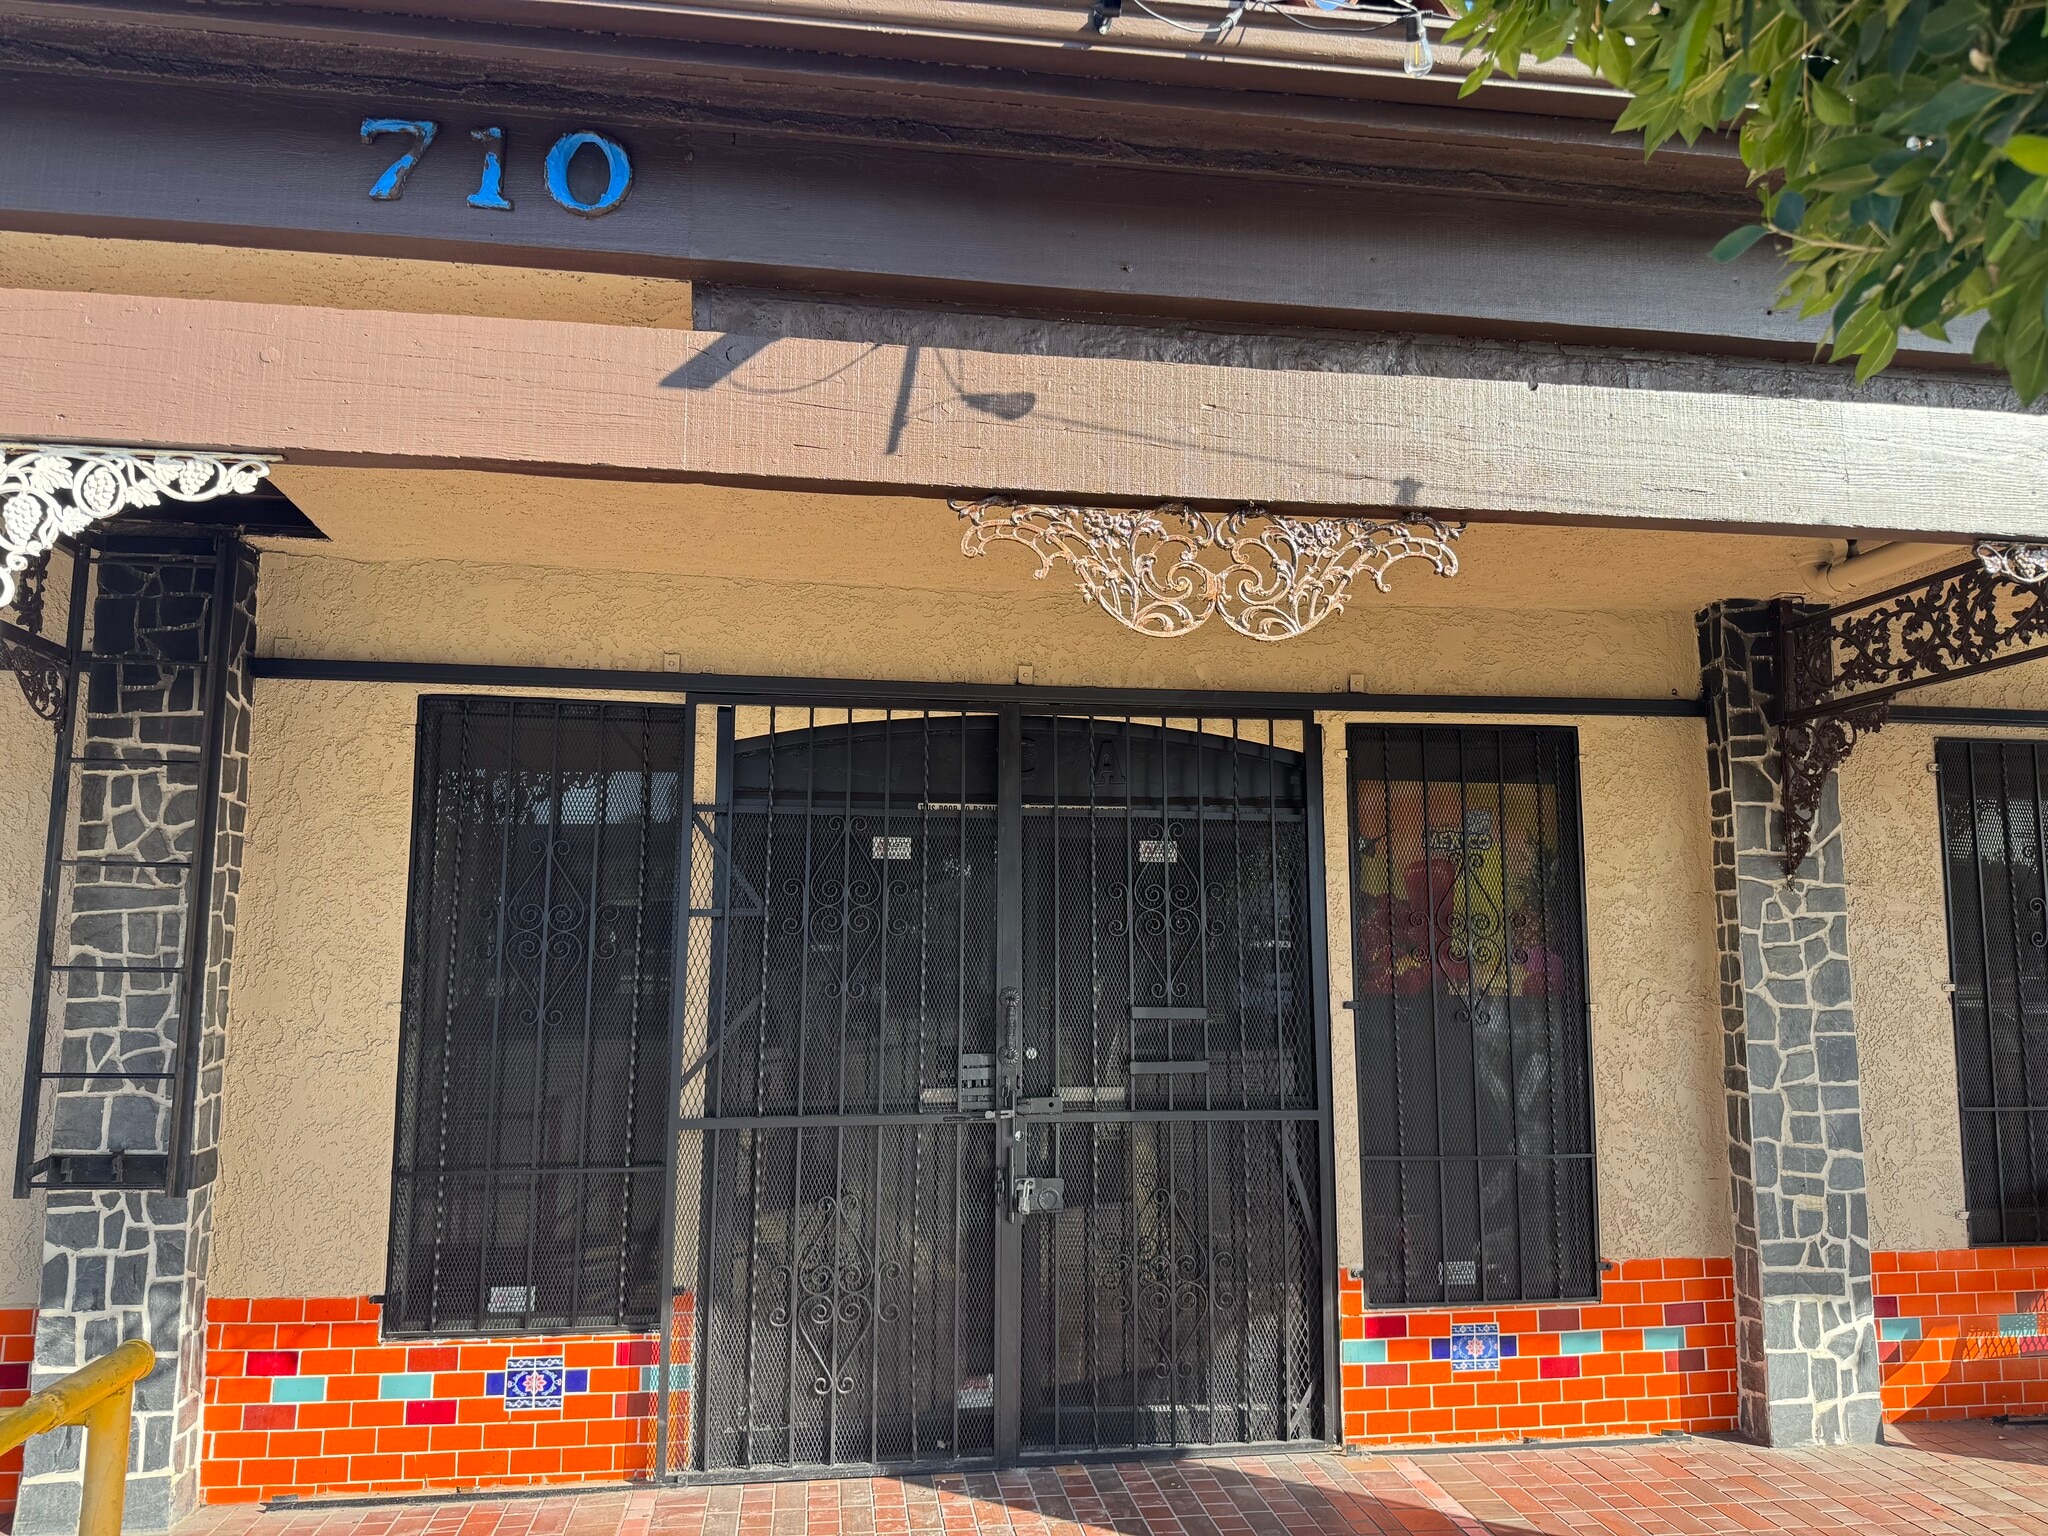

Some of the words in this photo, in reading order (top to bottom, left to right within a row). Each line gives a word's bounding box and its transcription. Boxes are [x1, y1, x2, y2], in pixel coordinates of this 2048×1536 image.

[360, 117, 633, 219] 710
[919, 803, 936, 811] TIS
[1422, 831, 1492, 850] MEXCO
